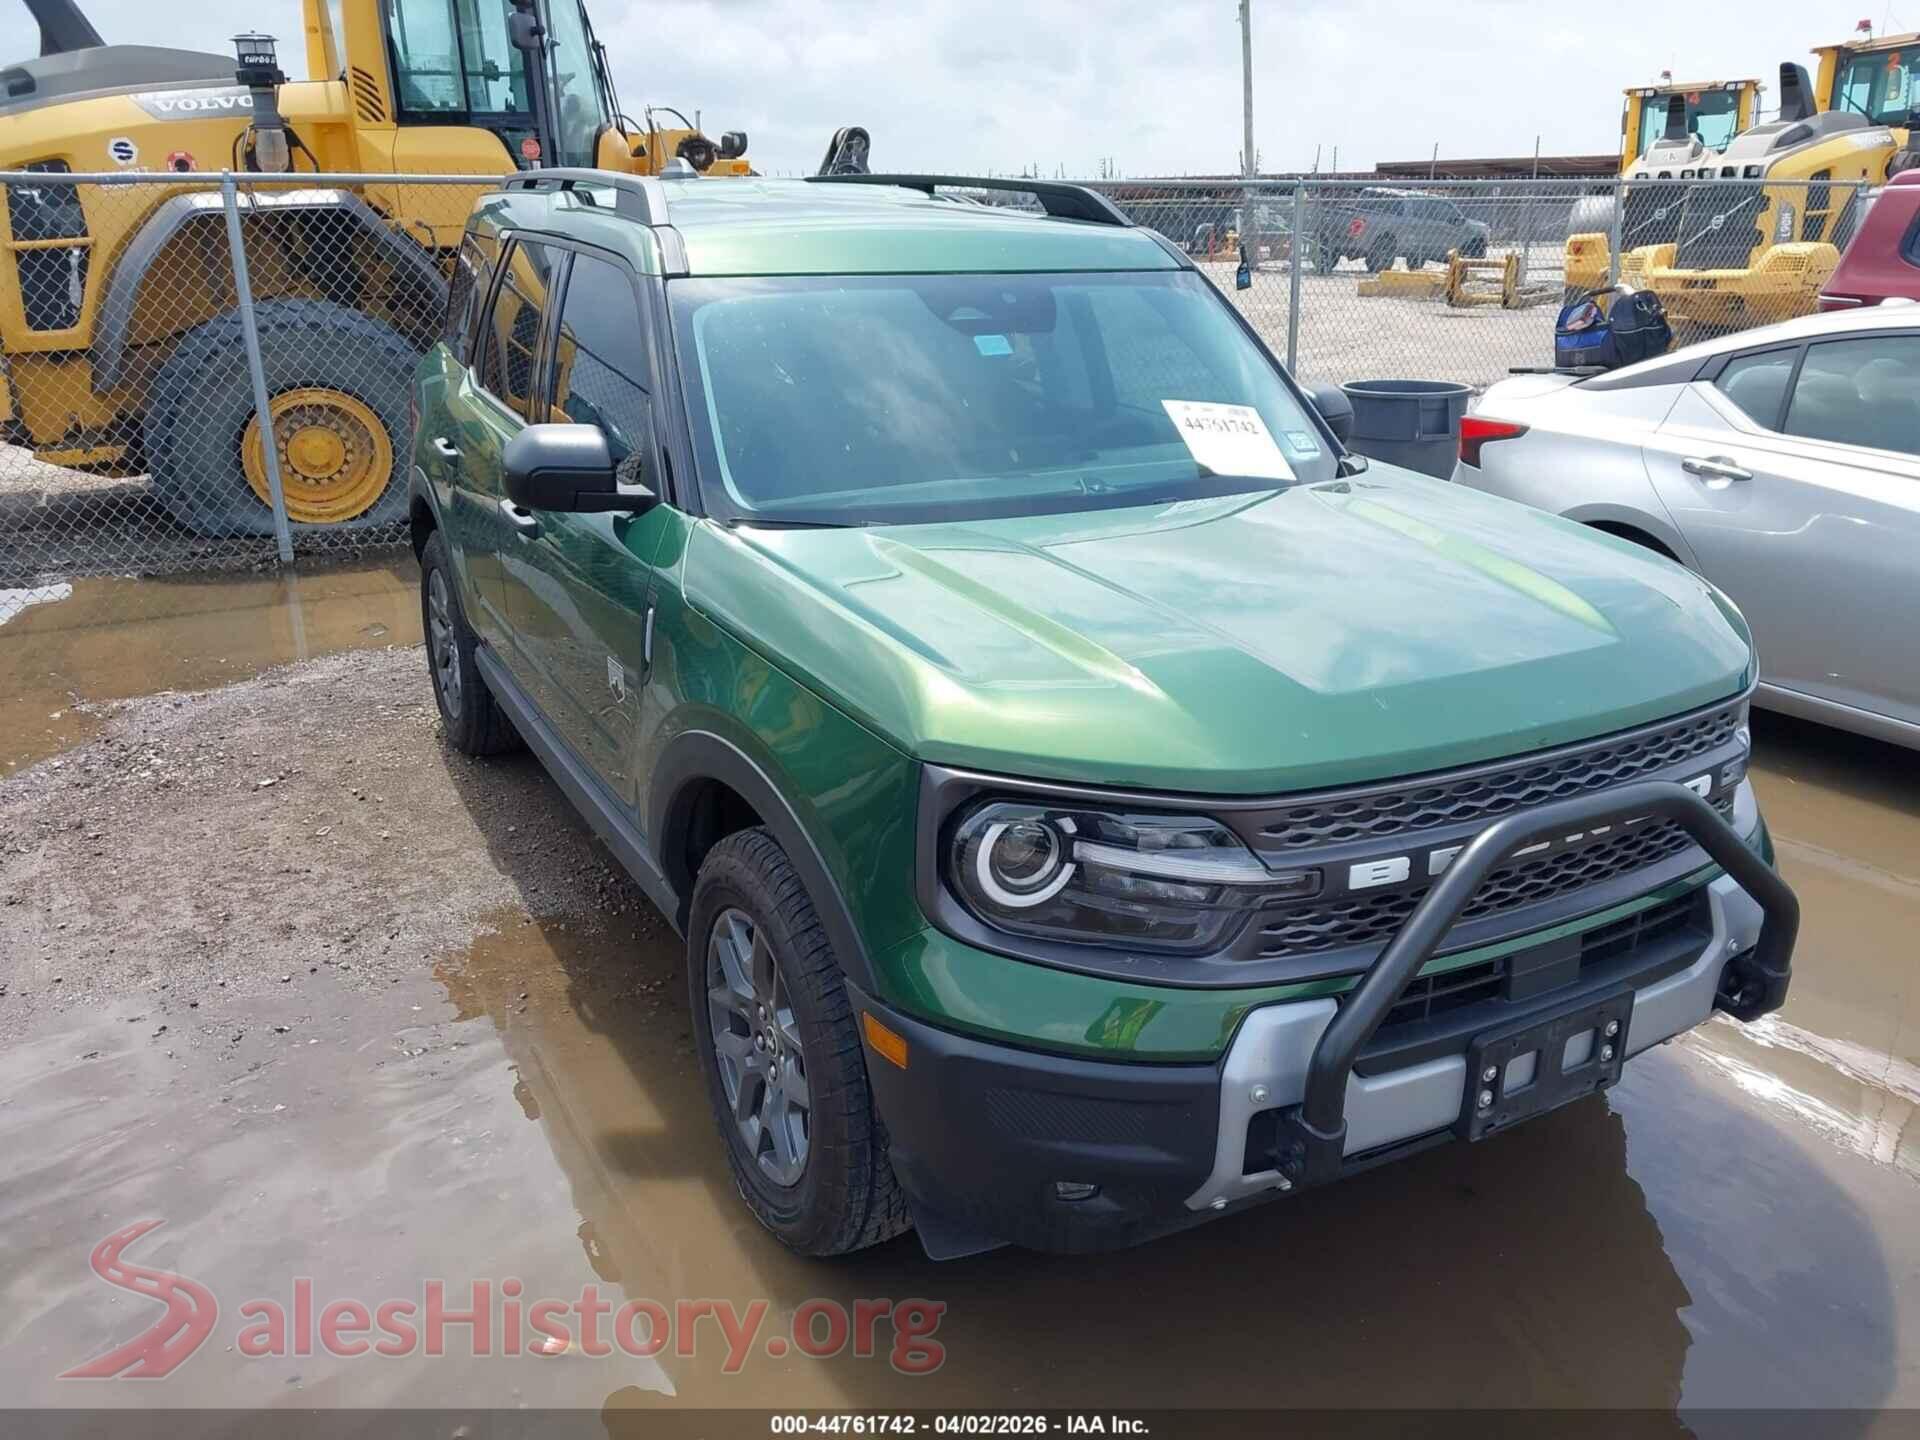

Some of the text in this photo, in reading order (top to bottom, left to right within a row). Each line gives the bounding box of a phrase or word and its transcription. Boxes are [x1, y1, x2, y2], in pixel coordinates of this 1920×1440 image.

[244, 55, 270, 64] turbo
[155, 95, 253, 111] VOLVO
[1184, 417, 1260, 435] 44761742
